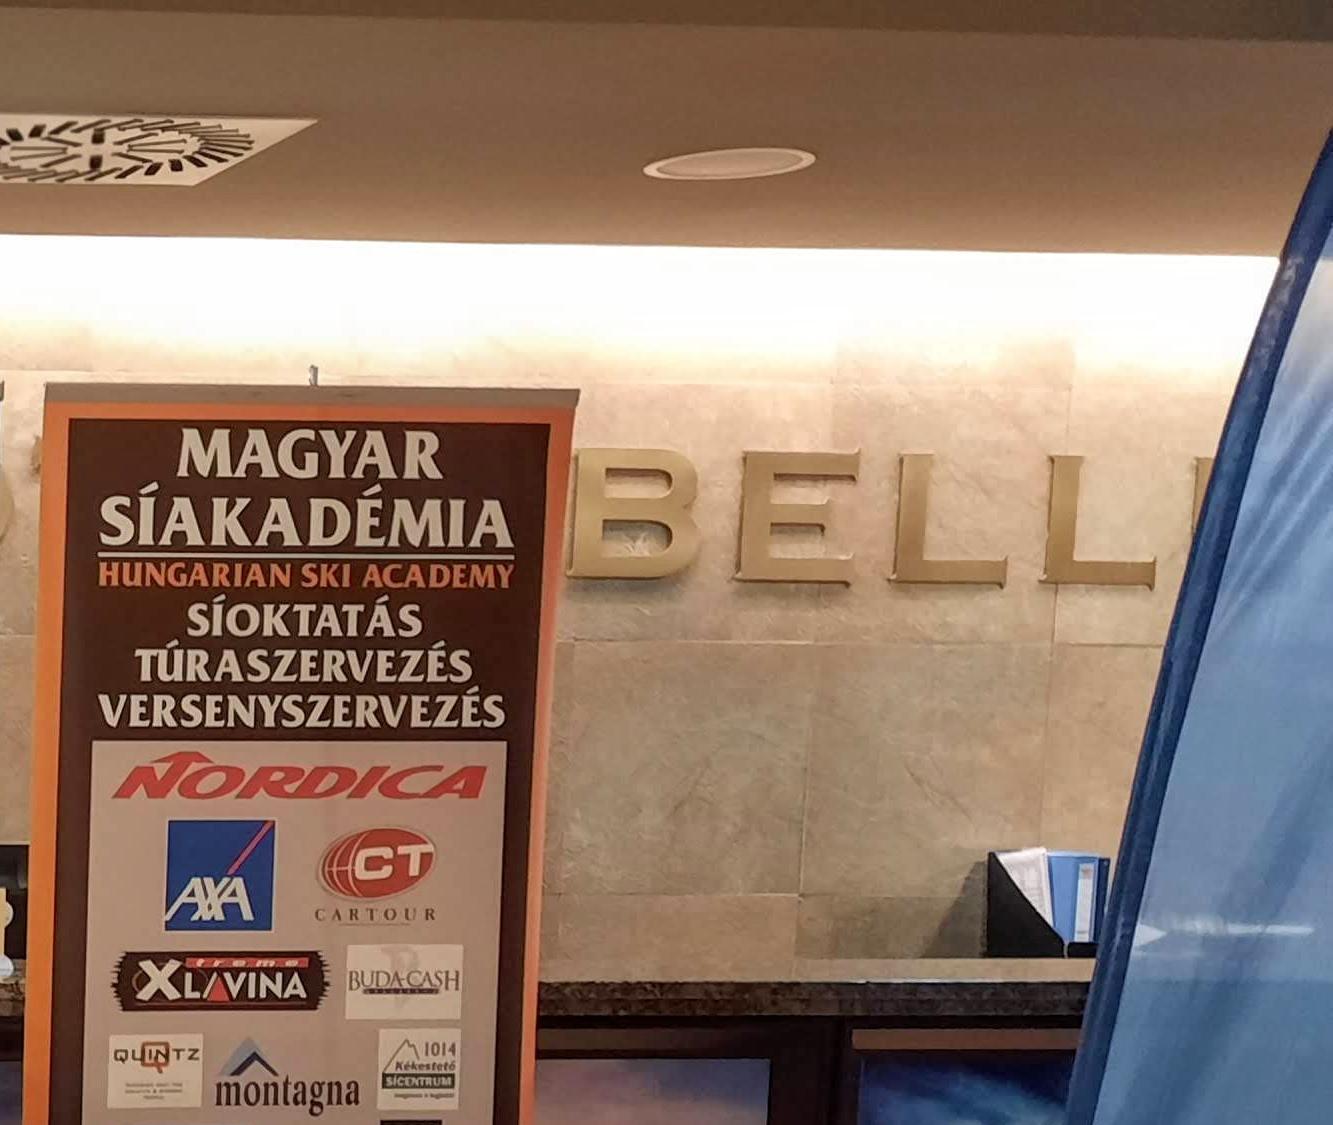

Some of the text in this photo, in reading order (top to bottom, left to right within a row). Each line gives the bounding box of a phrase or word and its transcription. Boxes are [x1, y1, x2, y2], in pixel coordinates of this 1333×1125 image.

[177, 427, 444, 480] MAGYAR
[99, 481, 515, 549] SÍAKADÉMIA
[566, 447, 1214, 590] BELL
[99, 561, 514, 589] HUNGARIAN SKI ACADEMY
[186, 593, 424, 638] SÍOKTATÁS
[134, 640, 473, 683] TÚRASZERVEZÉS
[98, 686, 507, 729] VERSENYSZERVEZÉS
[113, 751, 489, 800] NORDICA
[354, 843, 435, 881] CT
[165, 876, 256, 922] AXA
[314, 907, 436, 922] CARTOUR
[113, 1047, 201, 1065] QUINTZ
[424, 1041, 457, 1057] 1014
[214, 1074, 361, 1117] montagna
